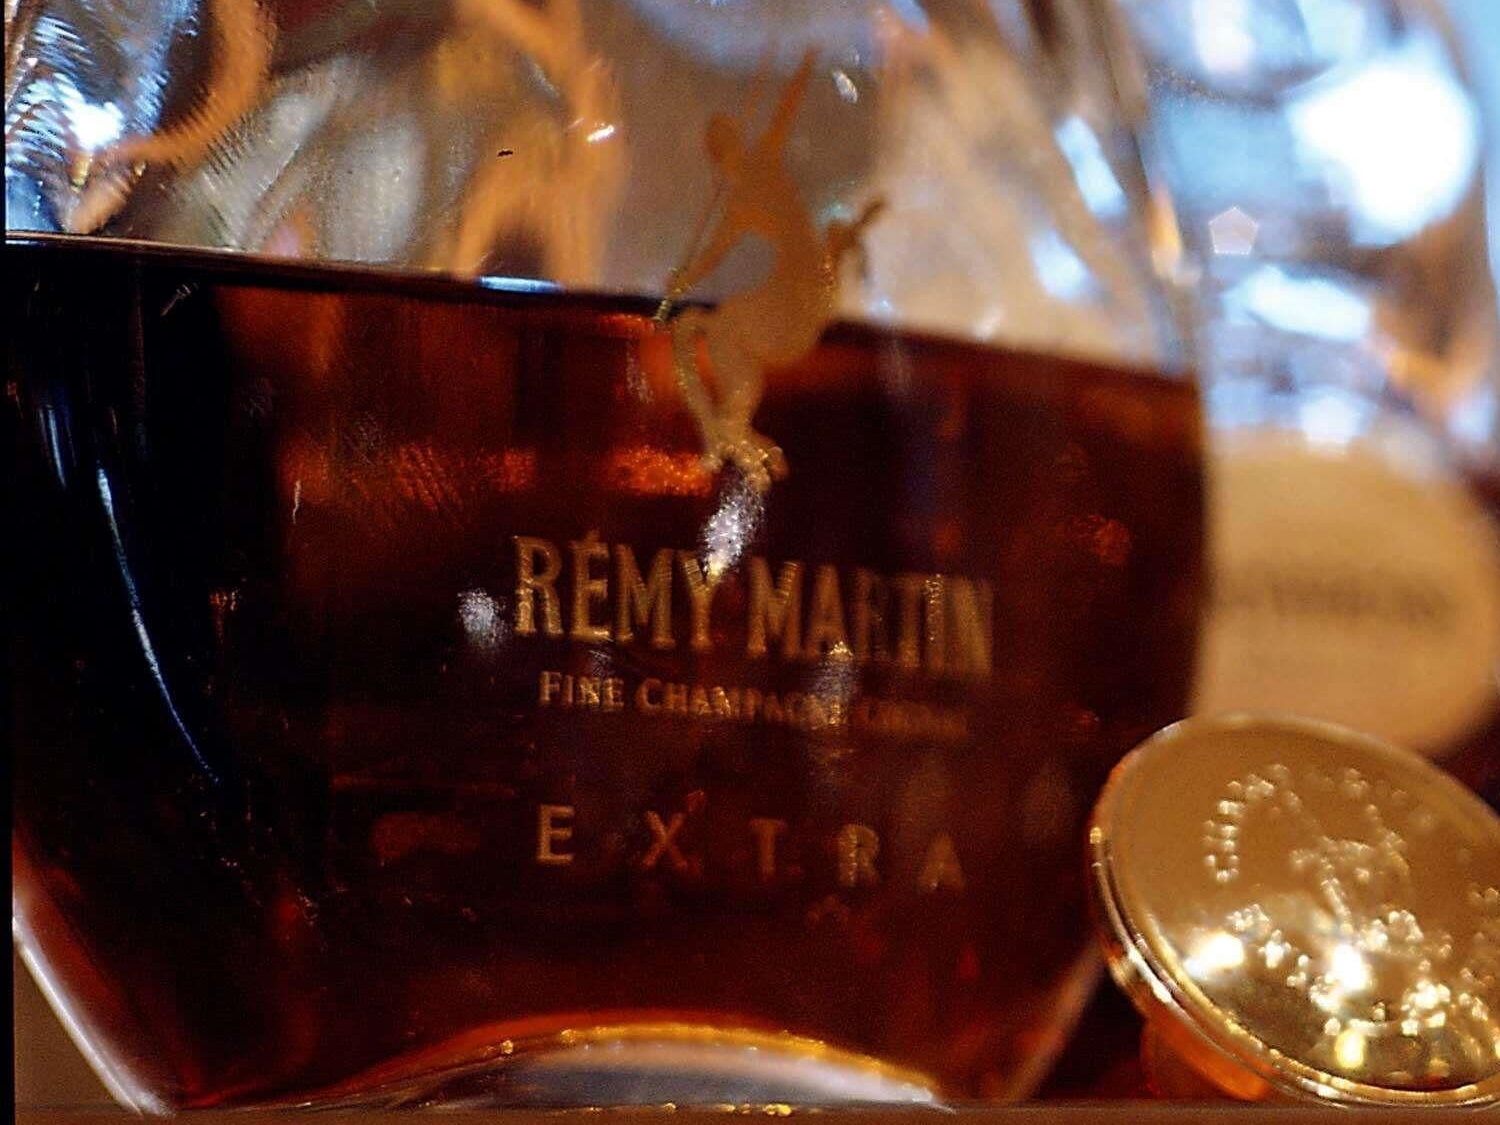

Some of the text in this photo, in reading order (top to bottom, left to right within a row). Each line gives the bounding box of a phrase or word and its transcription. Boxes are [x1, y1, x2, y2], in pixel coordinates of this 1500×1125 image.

[514, 531, 995, 678] RÉMY MARTIN
[539, 671, 625, 713] FINE
[536, 803, 967, 892] EXTRA
